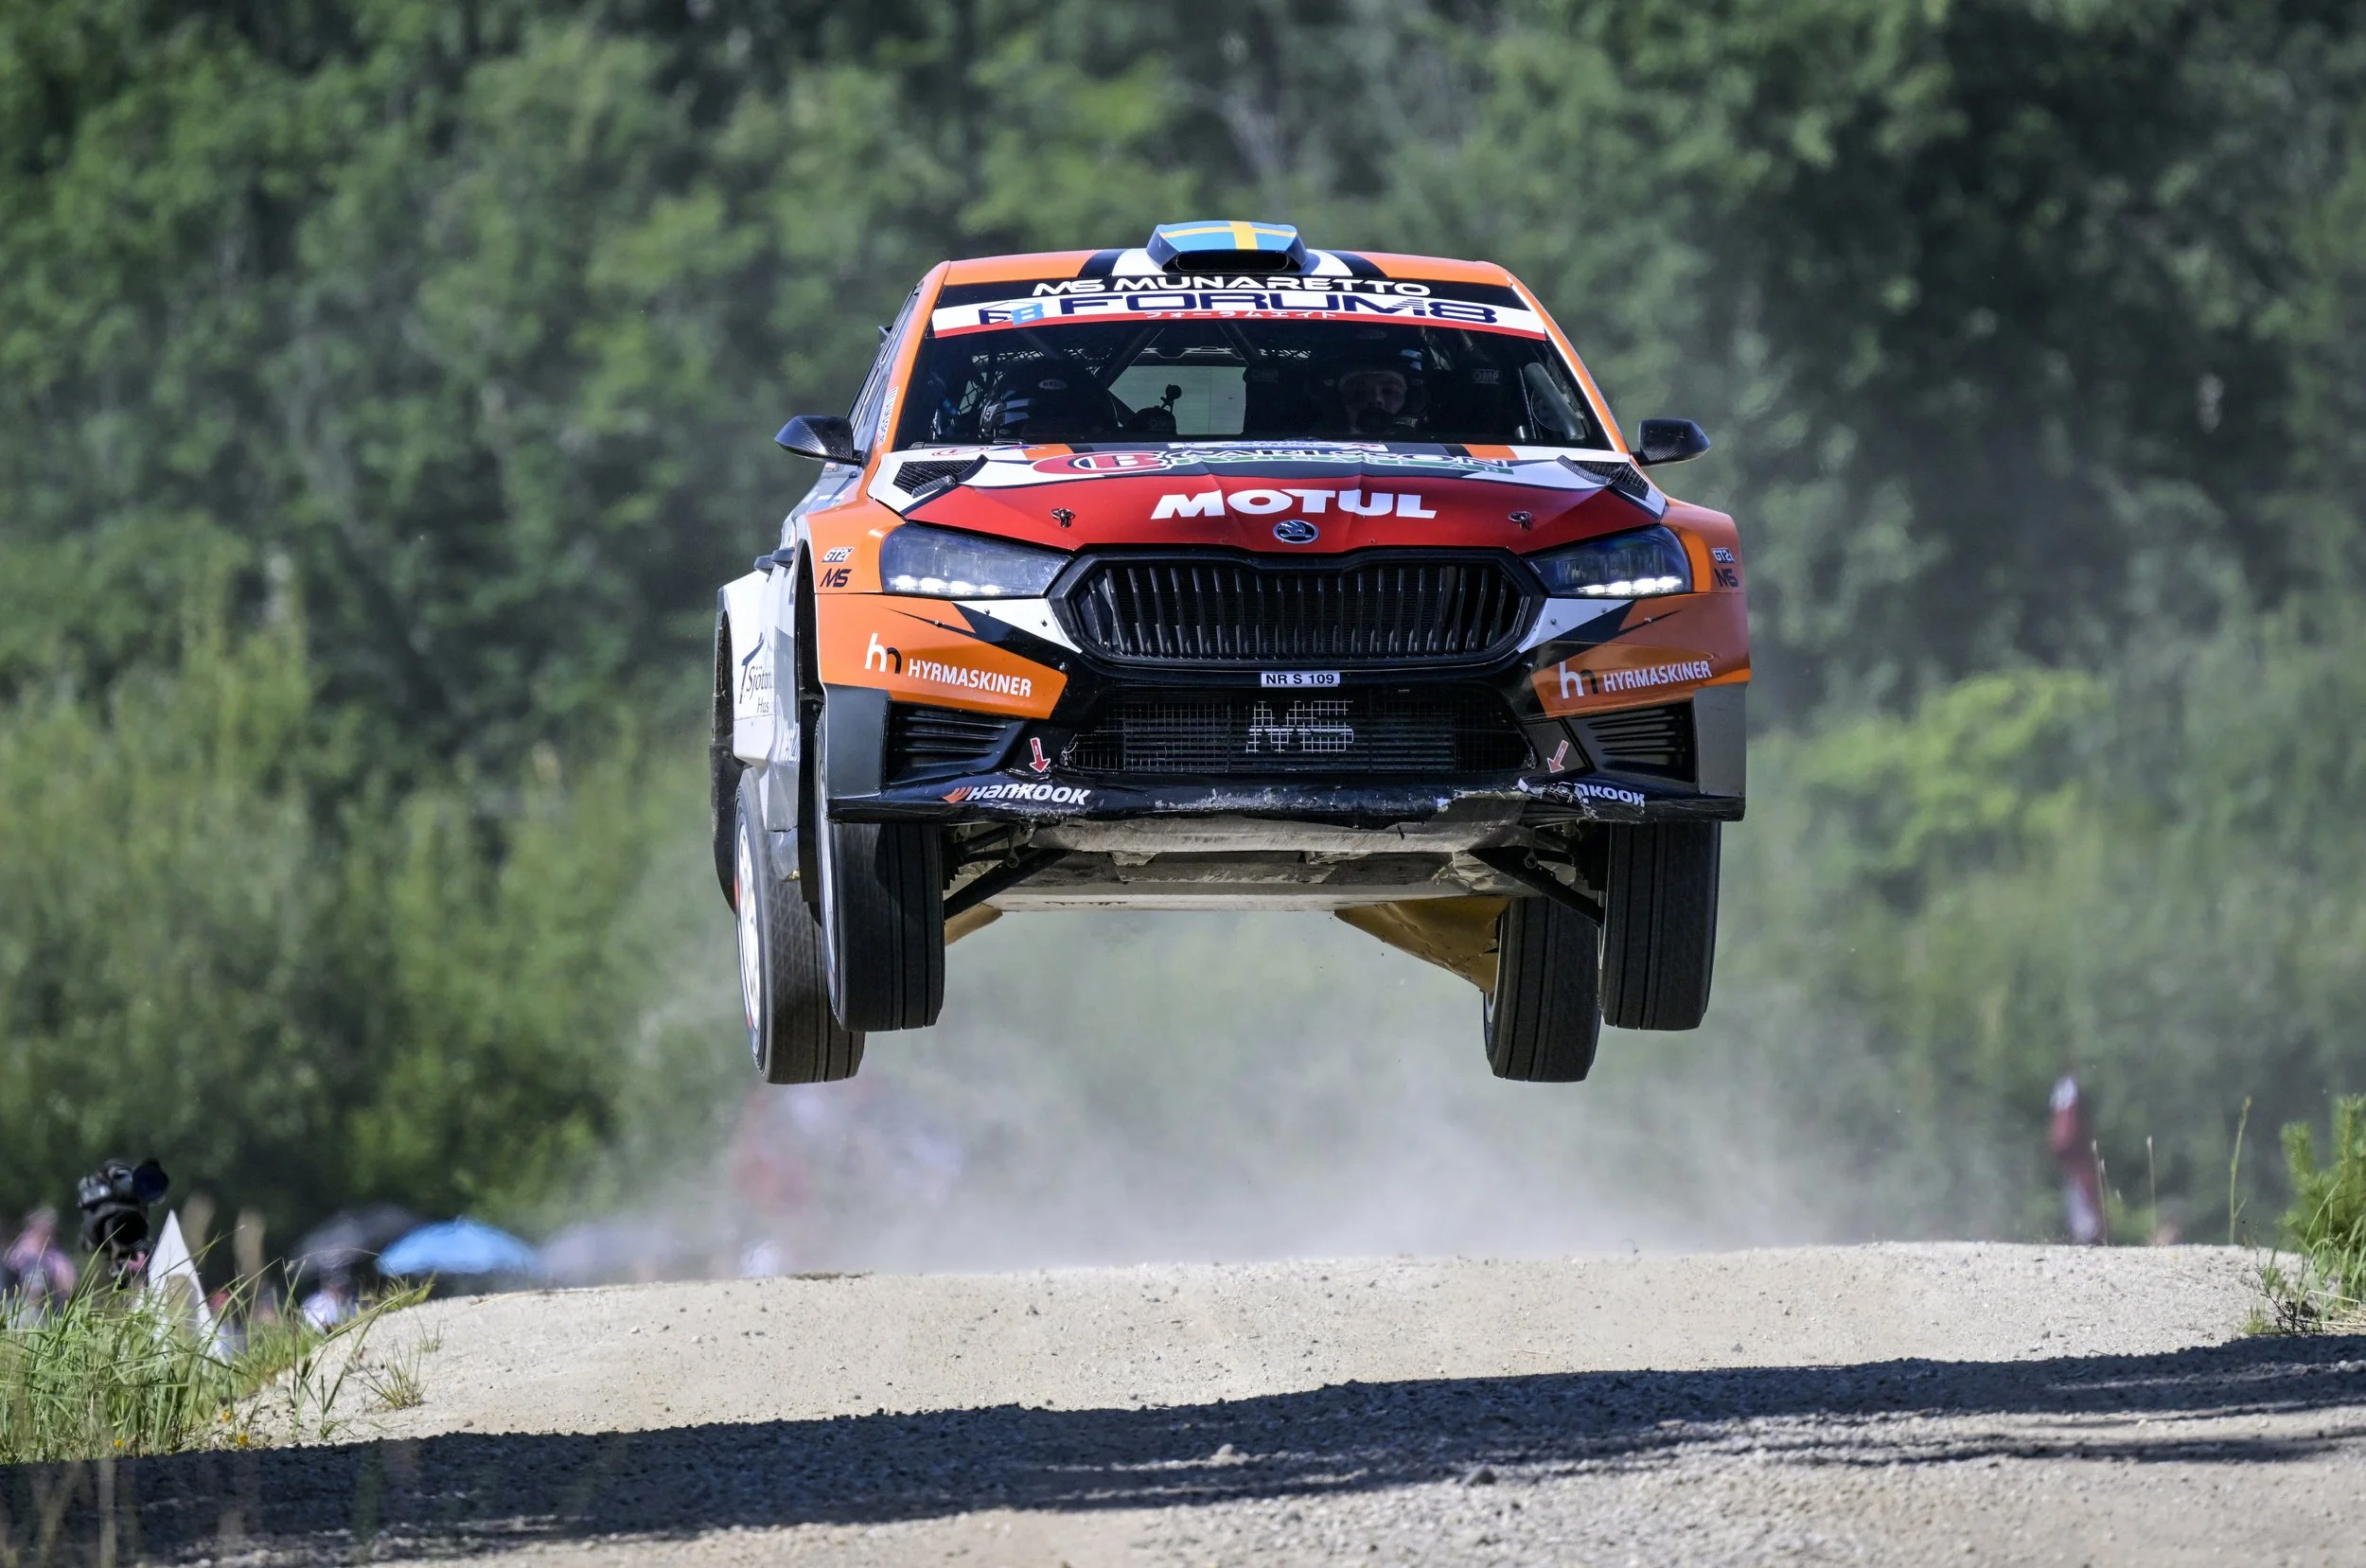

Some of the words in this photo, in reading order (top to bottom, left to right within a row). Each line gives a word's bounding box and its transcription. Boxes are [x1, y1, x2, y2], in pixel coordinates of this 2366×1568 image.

[1033, 278, 1106, 297] MS
[1113, 276, 1431, 297] MUNARETTO
[1059, 292, 1498, 324] FORUM8
[1143, 309, 1337, 319] フォーラムエイト
[1151, 488, 1438, 520] MOTUL
[820, 568, 853, 588] MS
[908, 658, 1032, 697] HYRMASKINER
[1266, 674, 1288, 685] NR
[1293, 674, 1303, 685] S
[1309, 674, 1335, 685] 109
[1603, 661, 1713, 693] HYRMASKINER
[756, 696, 769, 714] Hus
[1245, 700, 1355, 753] MS
